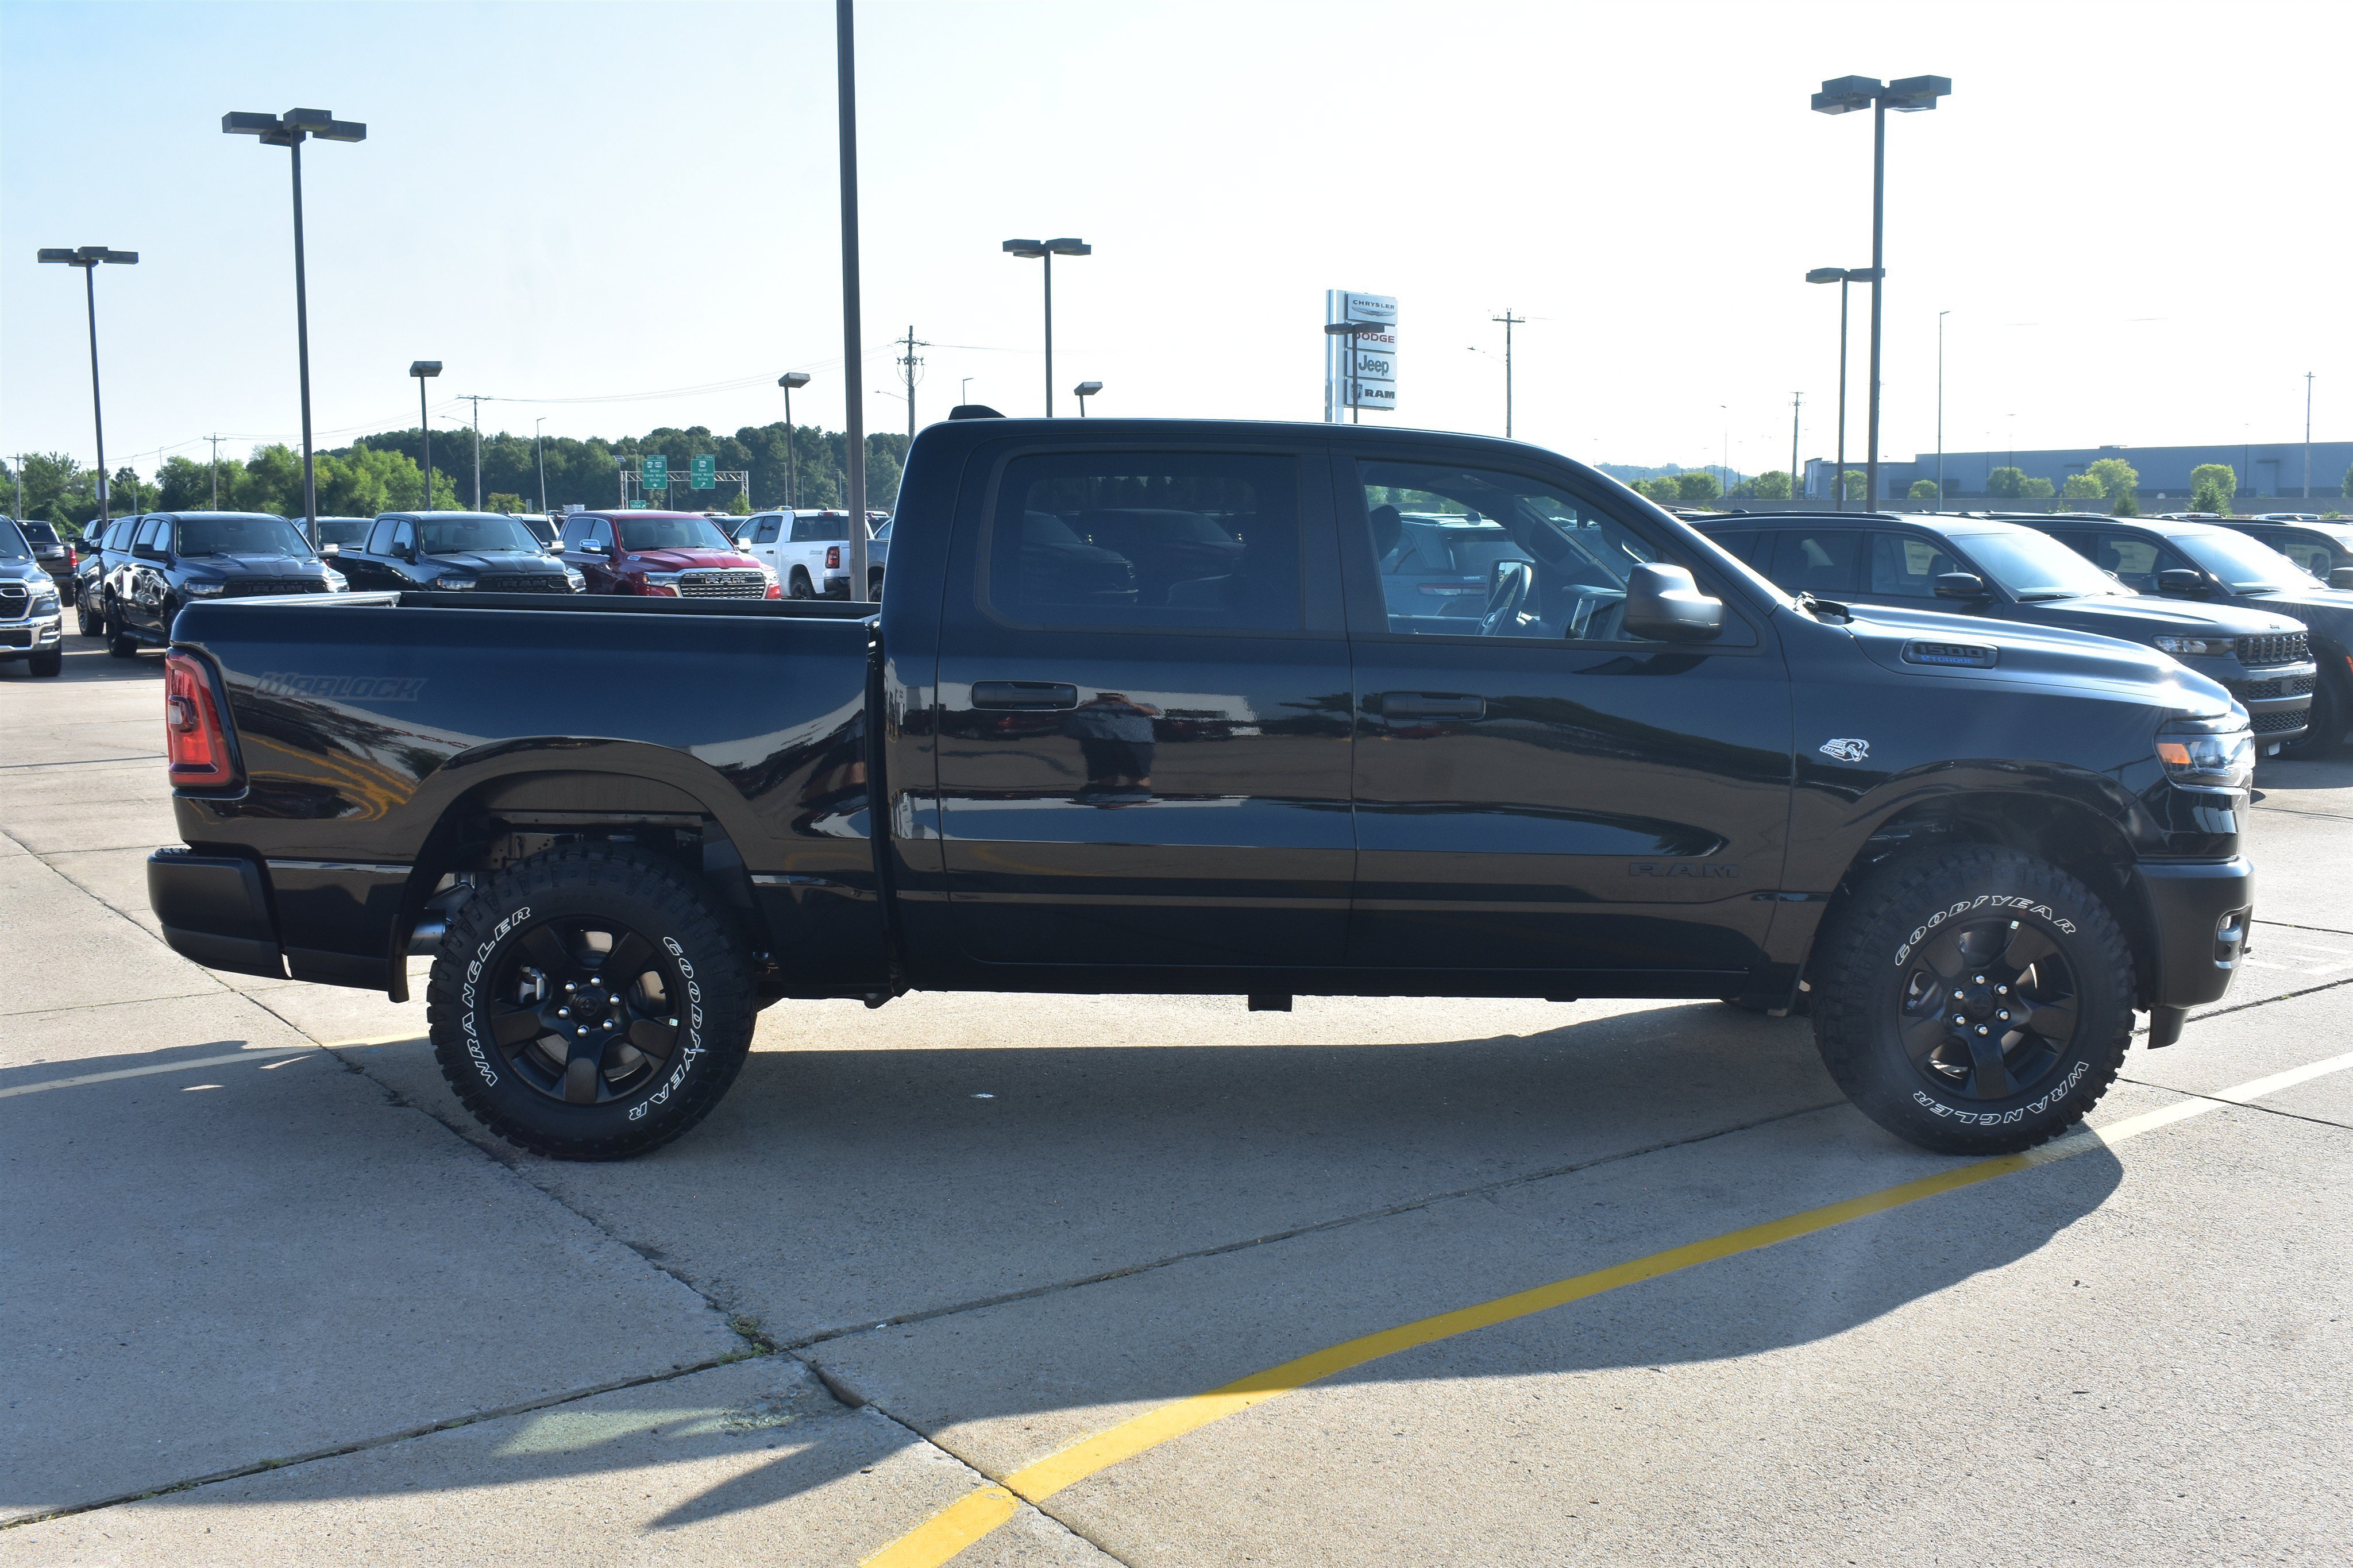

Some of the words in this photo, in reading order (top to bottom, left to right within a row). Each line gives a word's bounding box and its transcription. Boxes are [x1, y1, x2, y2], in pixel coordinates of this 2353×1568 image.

[1352, 299, 1395, 310] CHRYSLER
[1358, 354, 1389, 376] Jeep
[1364, 388, 1395, 399] RAM
[1920, 644, 1983, 658] 1500
[254, 671, 429, 702] WARLOCK
[1629, 863, 1740, 878] RAM
[1895, 895, 2077, 966] GOODYEAR
[462, 906, 531, 1087] WRANGLER
[628, 936, 703, 1121] GOODYEAR
[1913, 1061, 2089, 1126] WRANGLER
